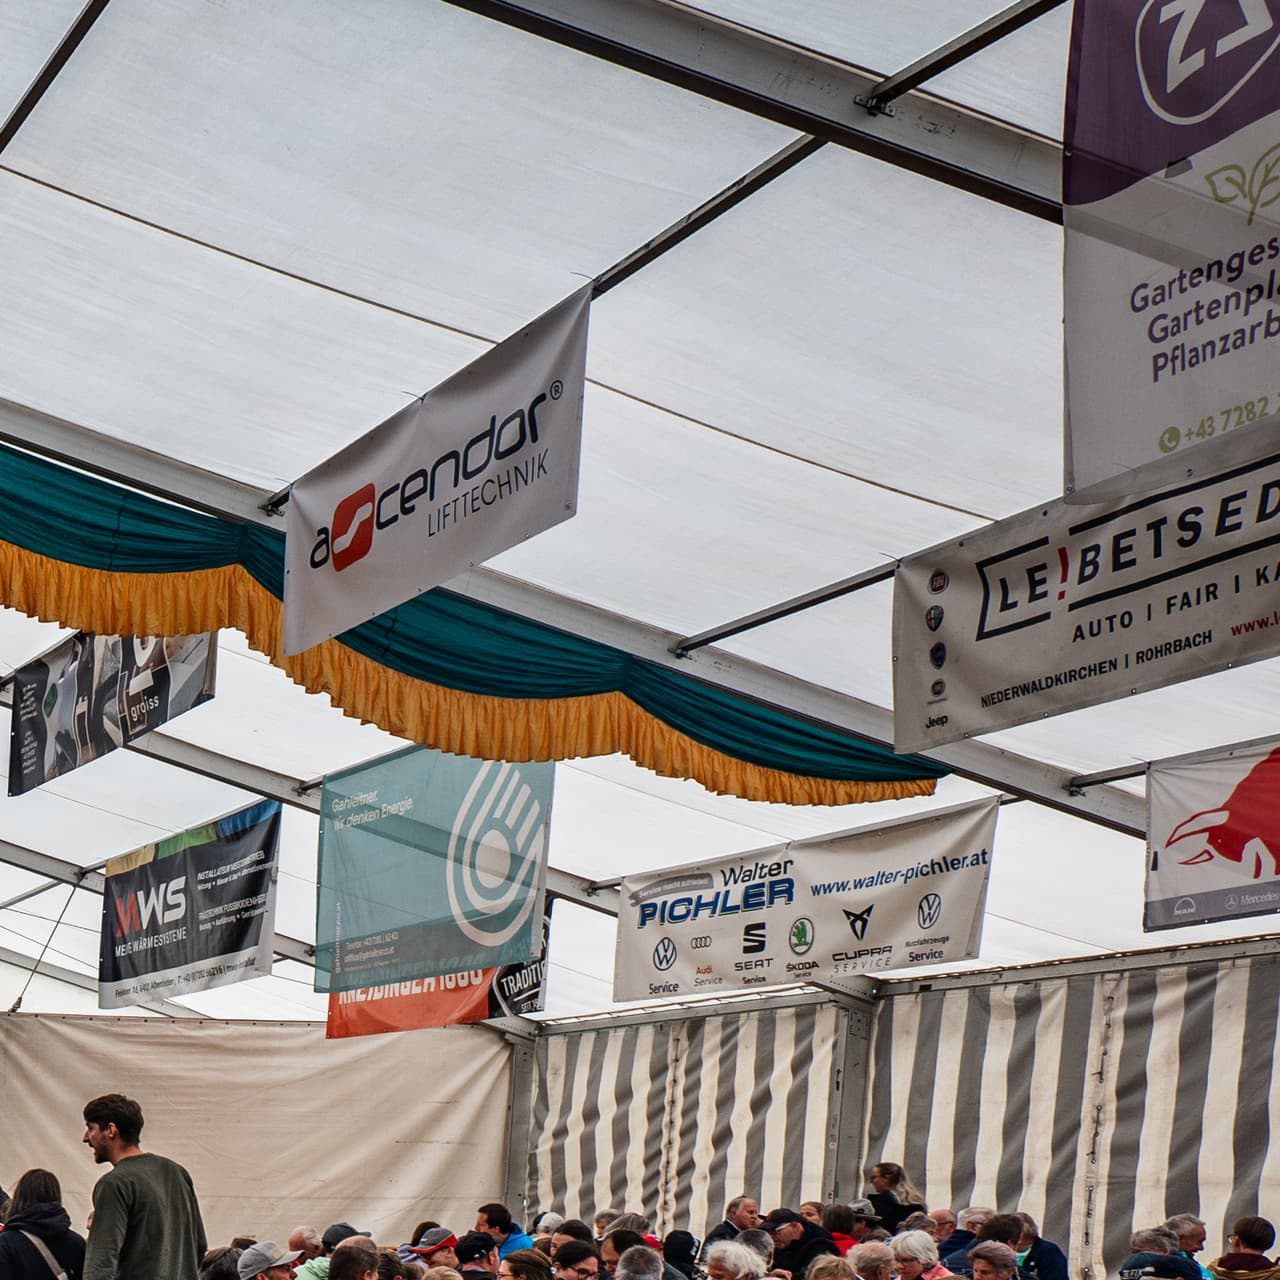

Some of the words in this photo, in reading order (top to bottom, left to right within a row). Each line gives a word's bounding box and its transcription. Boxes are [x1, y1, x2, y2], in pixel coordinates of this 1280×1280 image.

[1148, 268, 1280, 345] Gartenpl
[1184, 414, 1215, 443] +43
[1220, 395, 1269, 432] 7282
[427, 447, 549, 538] LIFTTECHNIK
[1072, 611, 1133, 643] AUTO
[1166, 582, 1219, 615] FAIR
[980, 658, 1118, 710] NIEDERWALDKIRCHEN
[1135, 630, 1213, 665] ROHRBACH
[130, 695, 159, 722] groiss
[925, 713, 949, 729] Jeep
[347, 809, 380, 827] denken
[720, 859, 794, 887] Walter
[810, 847, 988, 897] www.walter-pichler.at
[638, 877, 795, 930] PICHLER
[832, 945, 893, 962] CUPRA
[908, 949, 944, 962] Service
[696, 965, 713, 975] Audi
[734, 957, 774, 972] SEAT
[834, 958, 891, 974] SERVICE
[648, 981, 679, 995] Service
[693, 976, 724, 987] Service
[742, 975, 766, 985] Service
